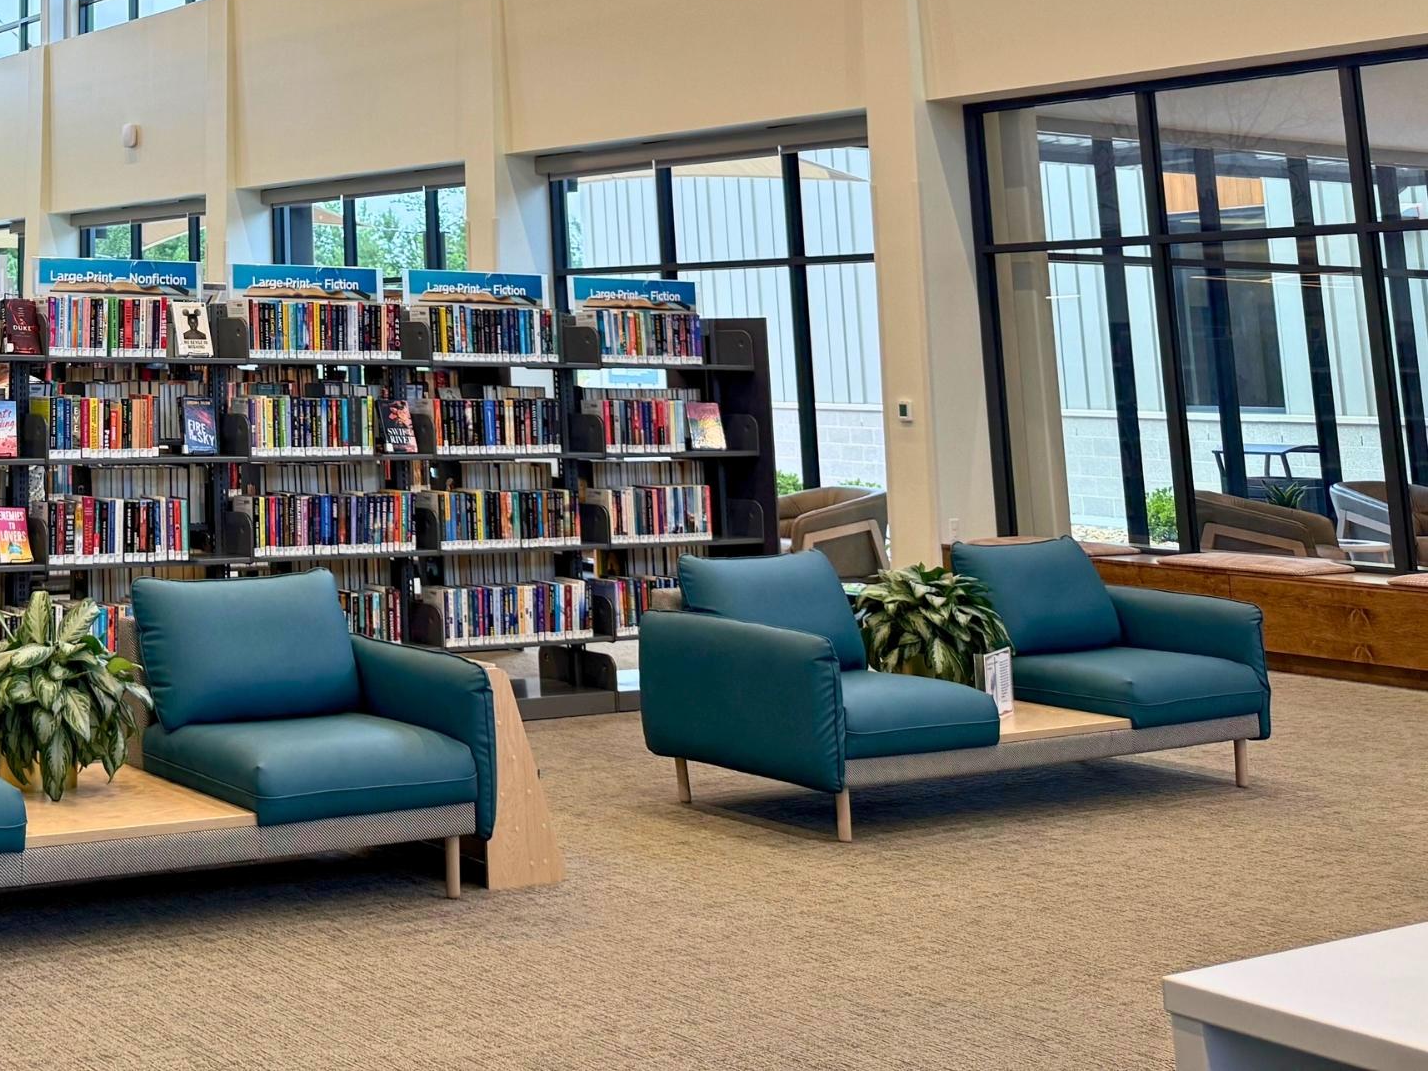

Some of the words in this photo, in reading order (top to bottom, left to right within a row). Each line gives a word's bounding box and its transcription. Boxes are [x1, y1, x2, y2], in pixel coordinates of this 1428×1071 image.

[129, 272, 187, 286] Nonfiction
[324, 278, 360, 290] Fiction
[493, 284, 526, 296] Fiction
[650, 290, 681, 302] Fiction
[188, 419, 206, 432] FIRE
[198, 432, 214, 446] SKY
[0, 531, 27, 542] LOVERS
